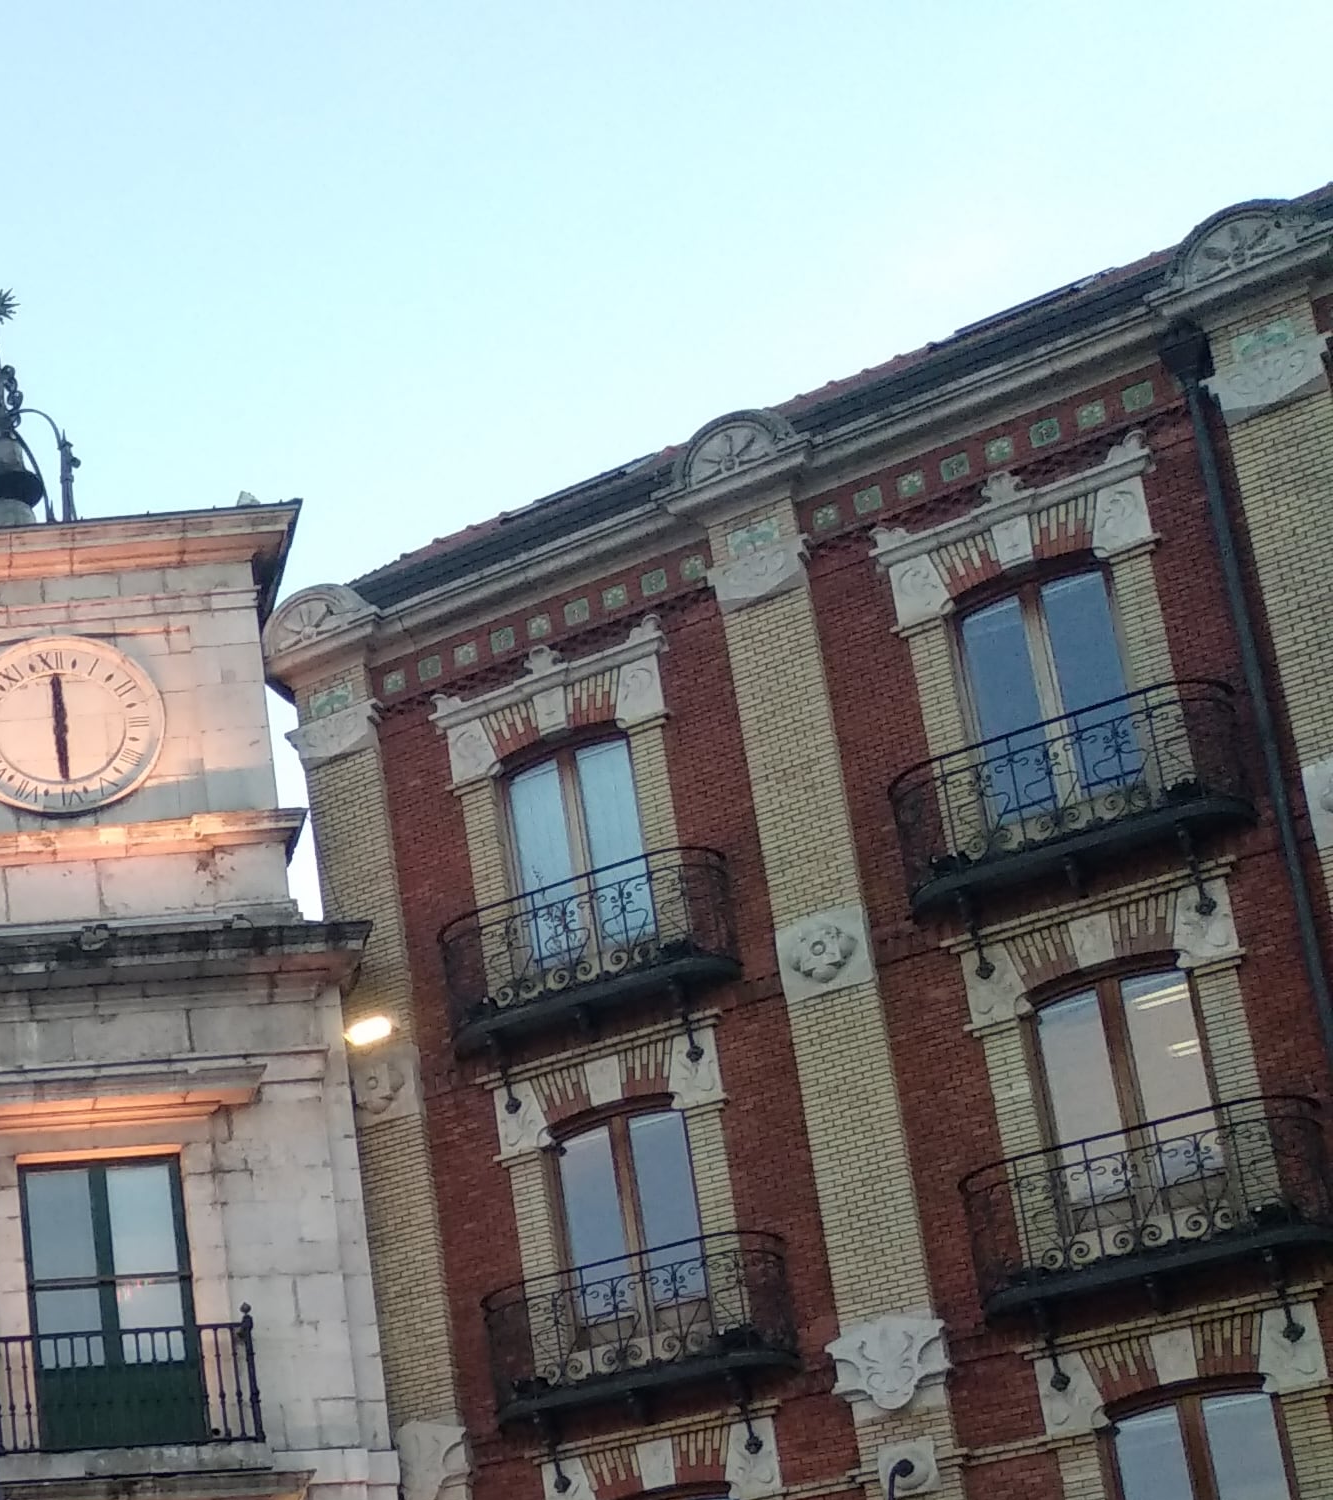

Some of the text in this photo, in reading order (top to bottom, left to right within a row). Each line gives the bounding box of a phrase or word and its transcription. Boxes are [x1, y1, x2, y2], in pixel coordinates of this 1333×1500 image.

[36, 651, 63, 672] XII
[88, 658, 100, 676] I
[0, 663, 24, 686] XI
[114, 679, 137, 698] II
[128, 716, 150, 728] III
[119, 748, 145, 767] IIII
[14, 780, 38, 803] VII
[99, 776, 119, 796] V
[61, 787, 84, 806] VI
